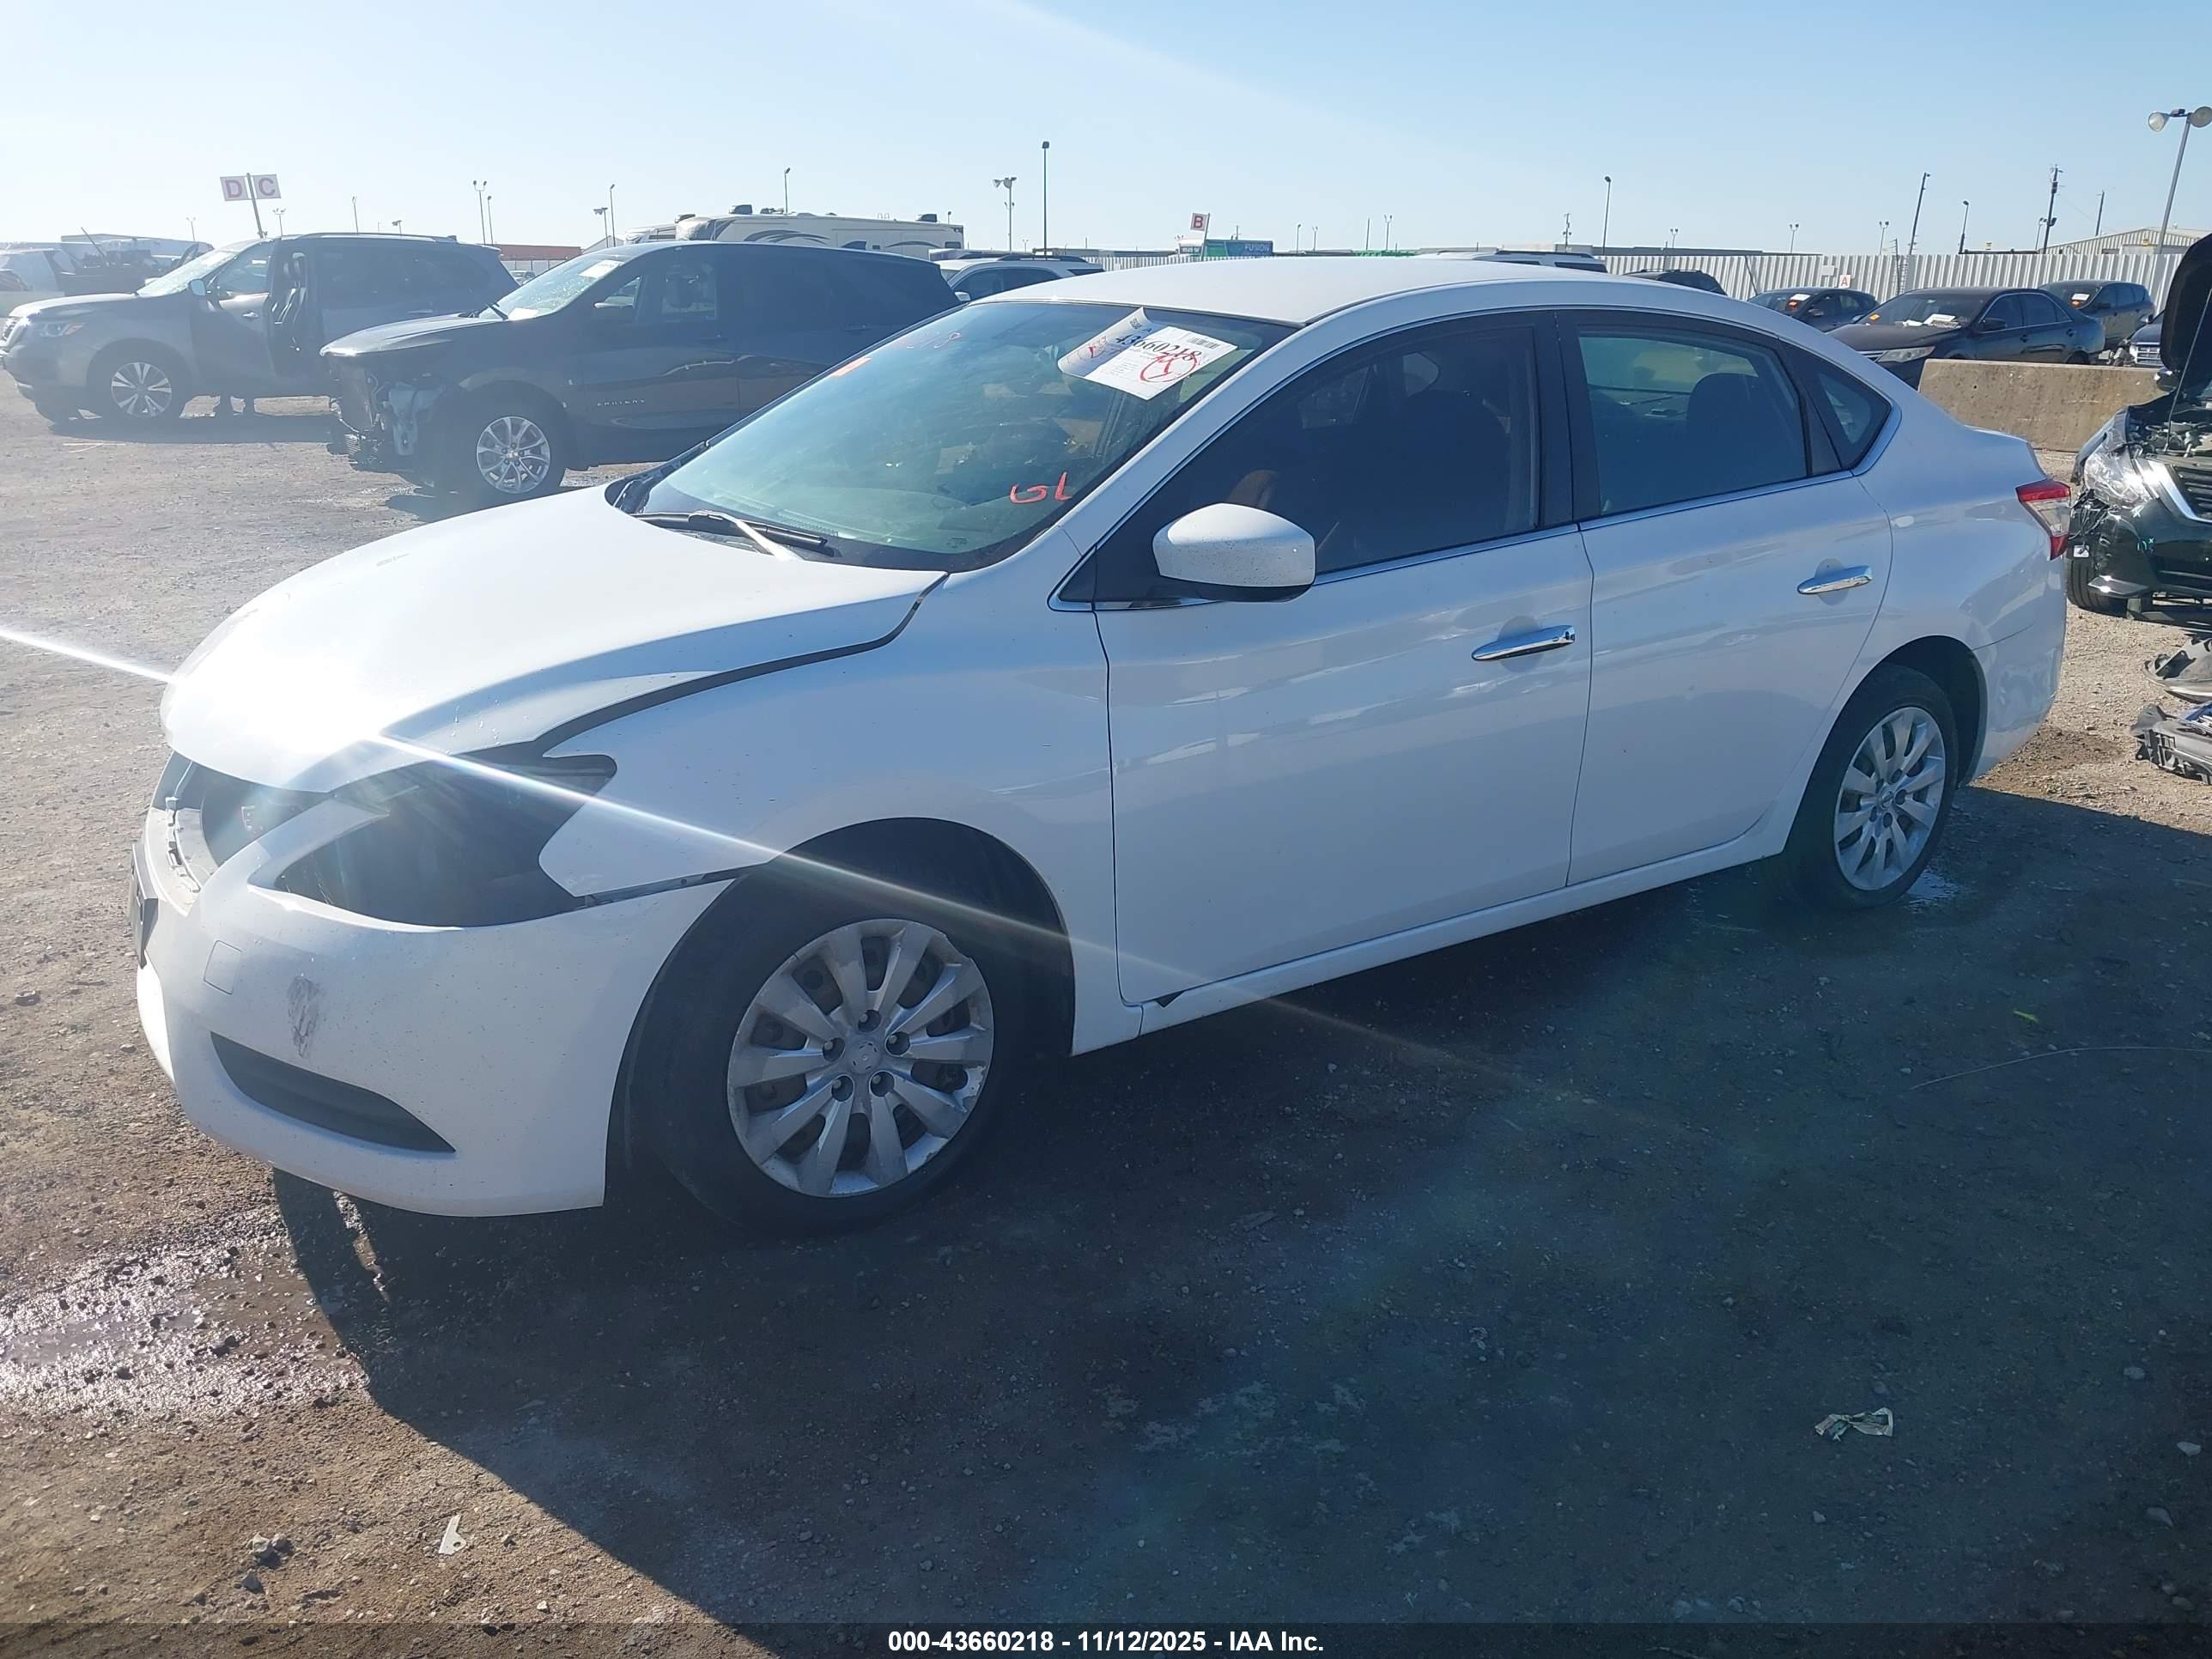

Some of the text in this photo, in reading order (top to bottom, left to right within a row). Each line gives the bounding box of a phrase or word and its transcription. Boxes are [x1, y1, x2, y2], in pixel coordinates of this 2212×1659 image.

[225, 179, 242, 198] D
[258, 177, 276, 197] C
[1193, 215, 1204, 228] B
[1840, 276, 1848, 287] A
[1115, 333, 1202, 362] 43660218
